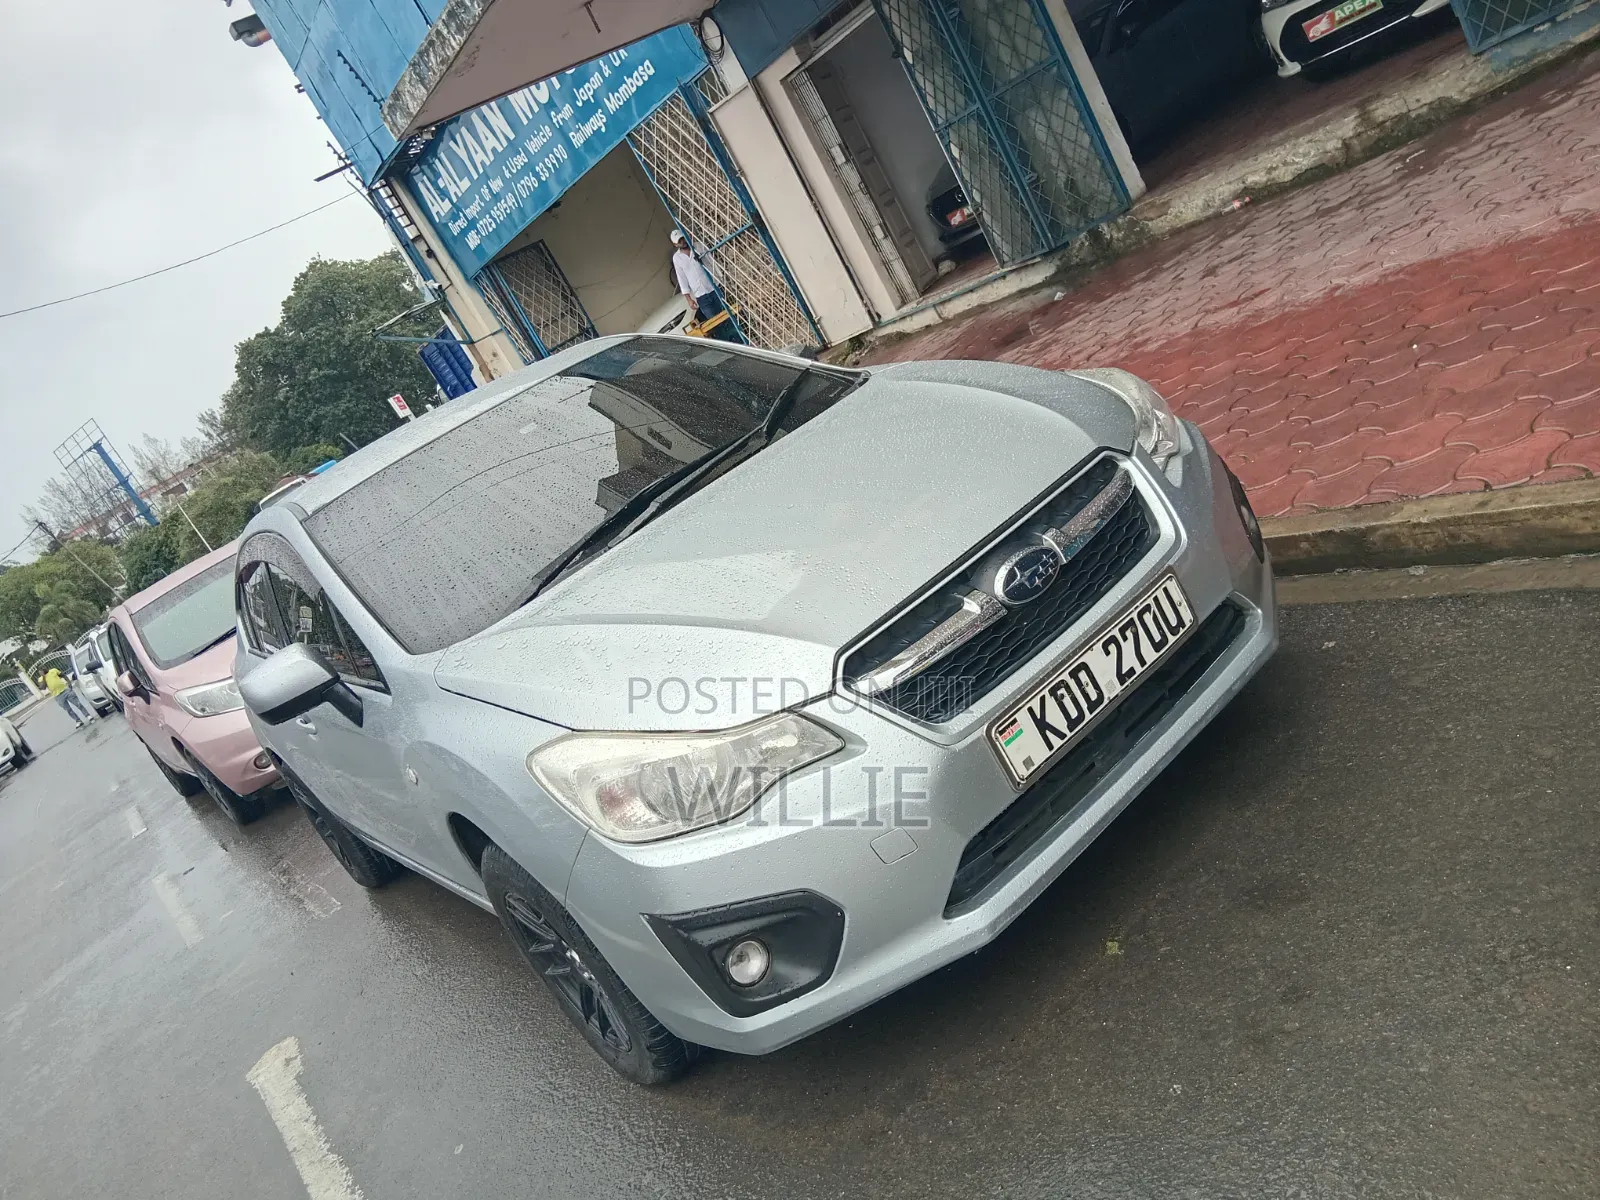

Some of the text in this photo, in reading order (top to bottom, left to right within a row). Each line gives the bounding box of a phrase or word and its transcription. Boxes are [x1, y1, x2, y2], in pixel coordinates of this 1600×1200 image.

[449, 213, 467, 235] Direct
[463, 195, 484, 219] Import
[488, 176, 503, 193] New
[507, 148, 528, 173] Used
[525, 125, 552, 154] Vehicle
[551, 104, 573, 128] from
[574, 73, 603, 106] Japan
[600, 60, 611, 77] &
[569, 109, 606, 148] Railways
[604, 60, 654, 114] Mombasa
[1026, 586, 1186, 751] KDD 270U
